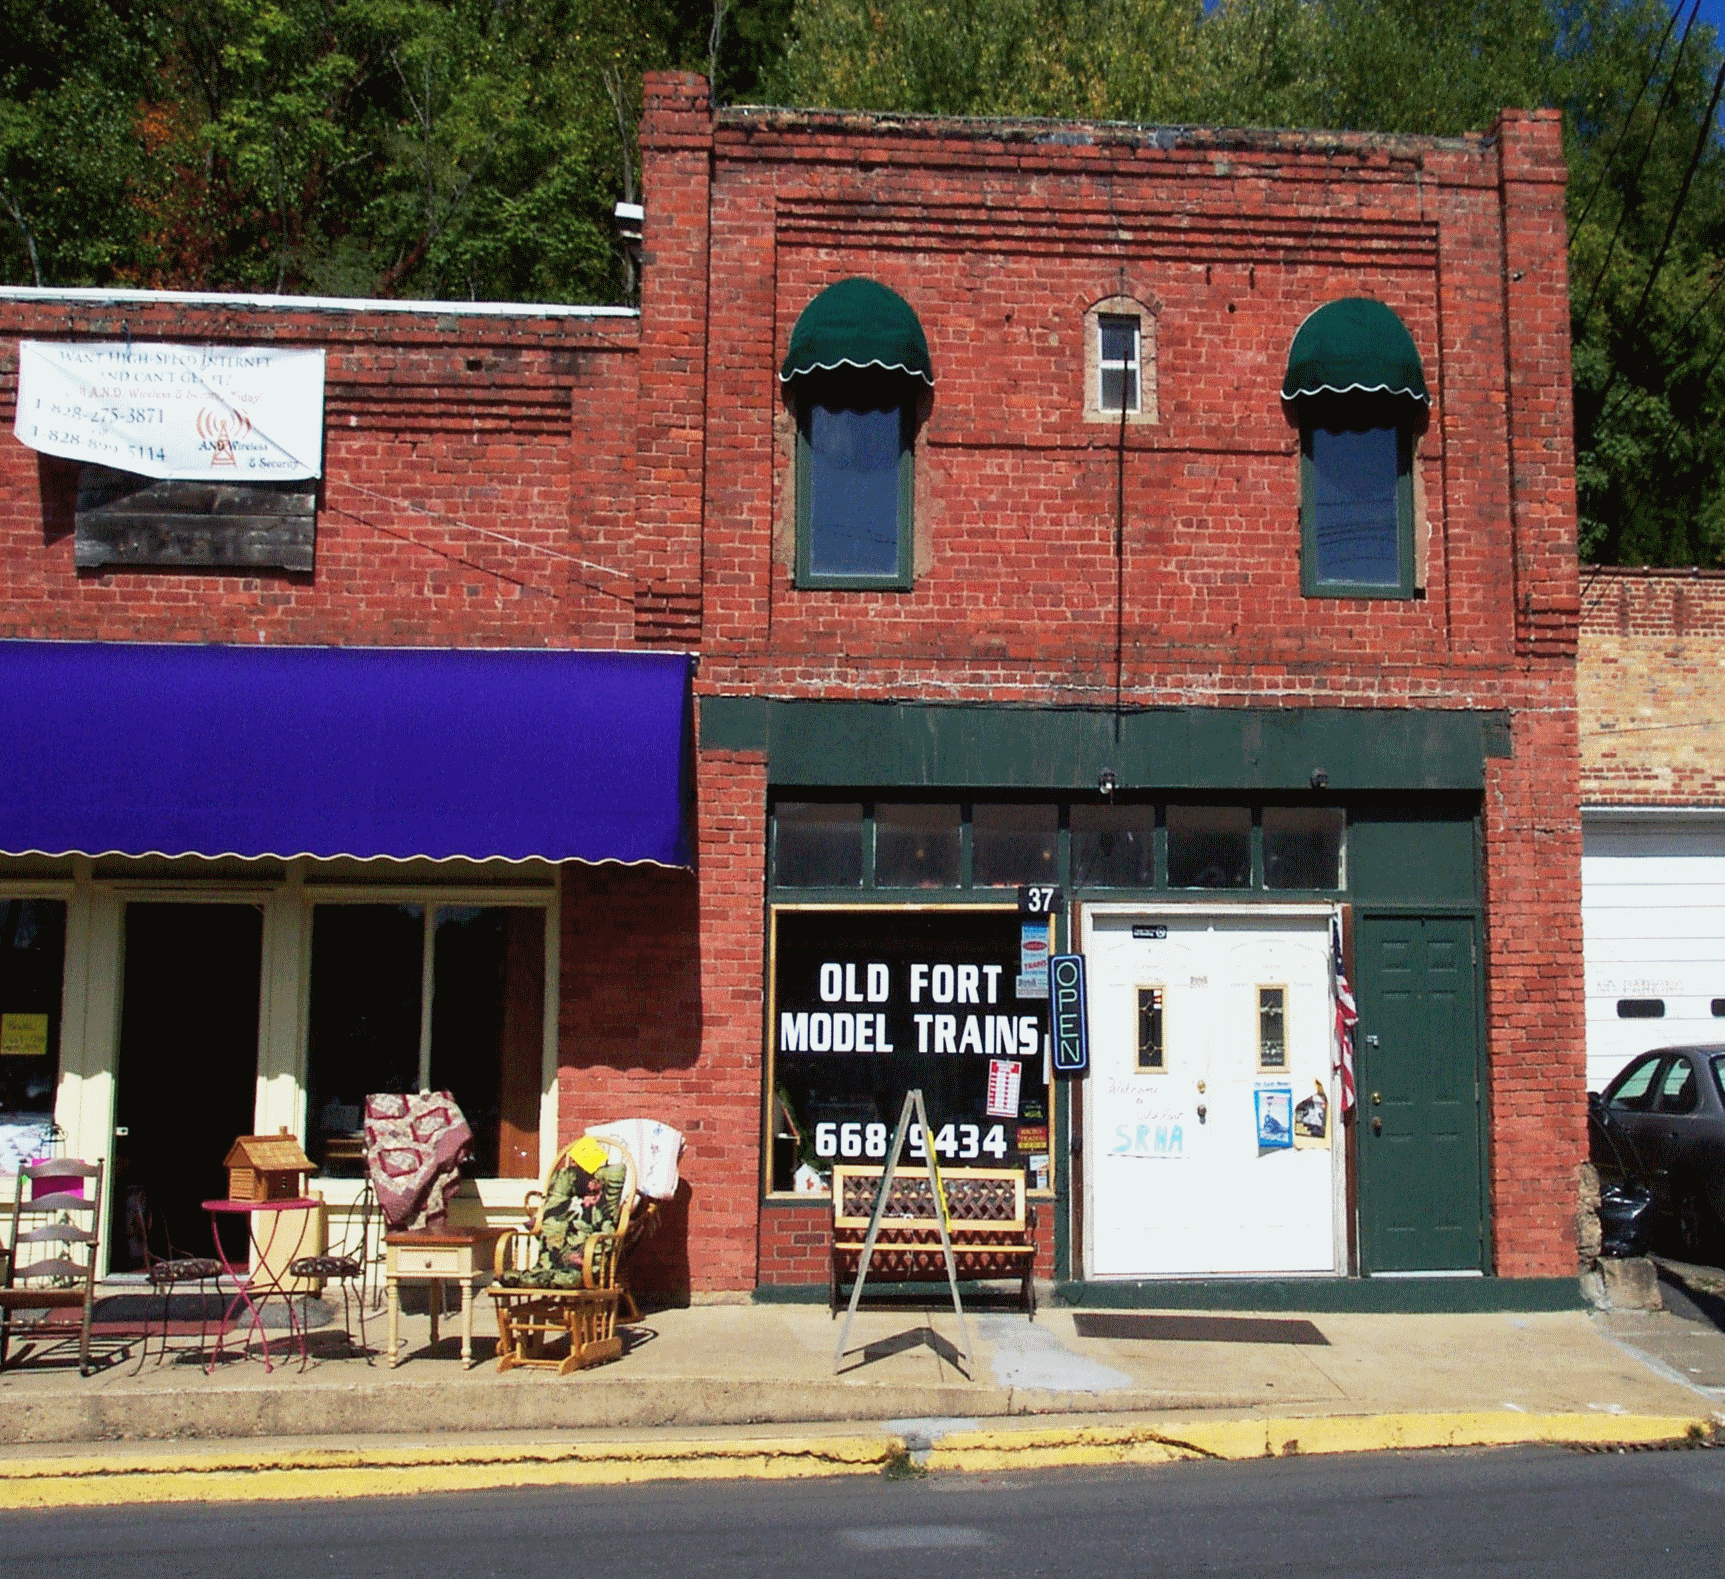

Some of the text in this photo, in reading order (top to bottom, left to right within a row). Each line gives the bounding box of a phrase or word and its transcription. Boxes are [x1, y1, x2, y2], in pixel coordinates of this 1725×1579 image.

[60, 351, 105, 363] WANT
[201, 355, 274, 368] INTERNET
[99, 371, 131, 382] ND
[133, 371, 176, 383] CANT
[128, 387, 172, 400] Wireless
[230, 390, 263, 405] Tday!
[32, 425, 167, 462] 1-828-8995114
[227, 440, 269, 452] Wireless
[258, 457, 300, 471] Security
[1028, 888, 1054, 912] 37
[820, 963, 1003, 1004] OLD FORT
[1056, 962, 1080, 1063] OPEN
[781, 1013, 1039, 1055] MODEL TRAINS
[815, 1122, 1008, 1159] 6689434
